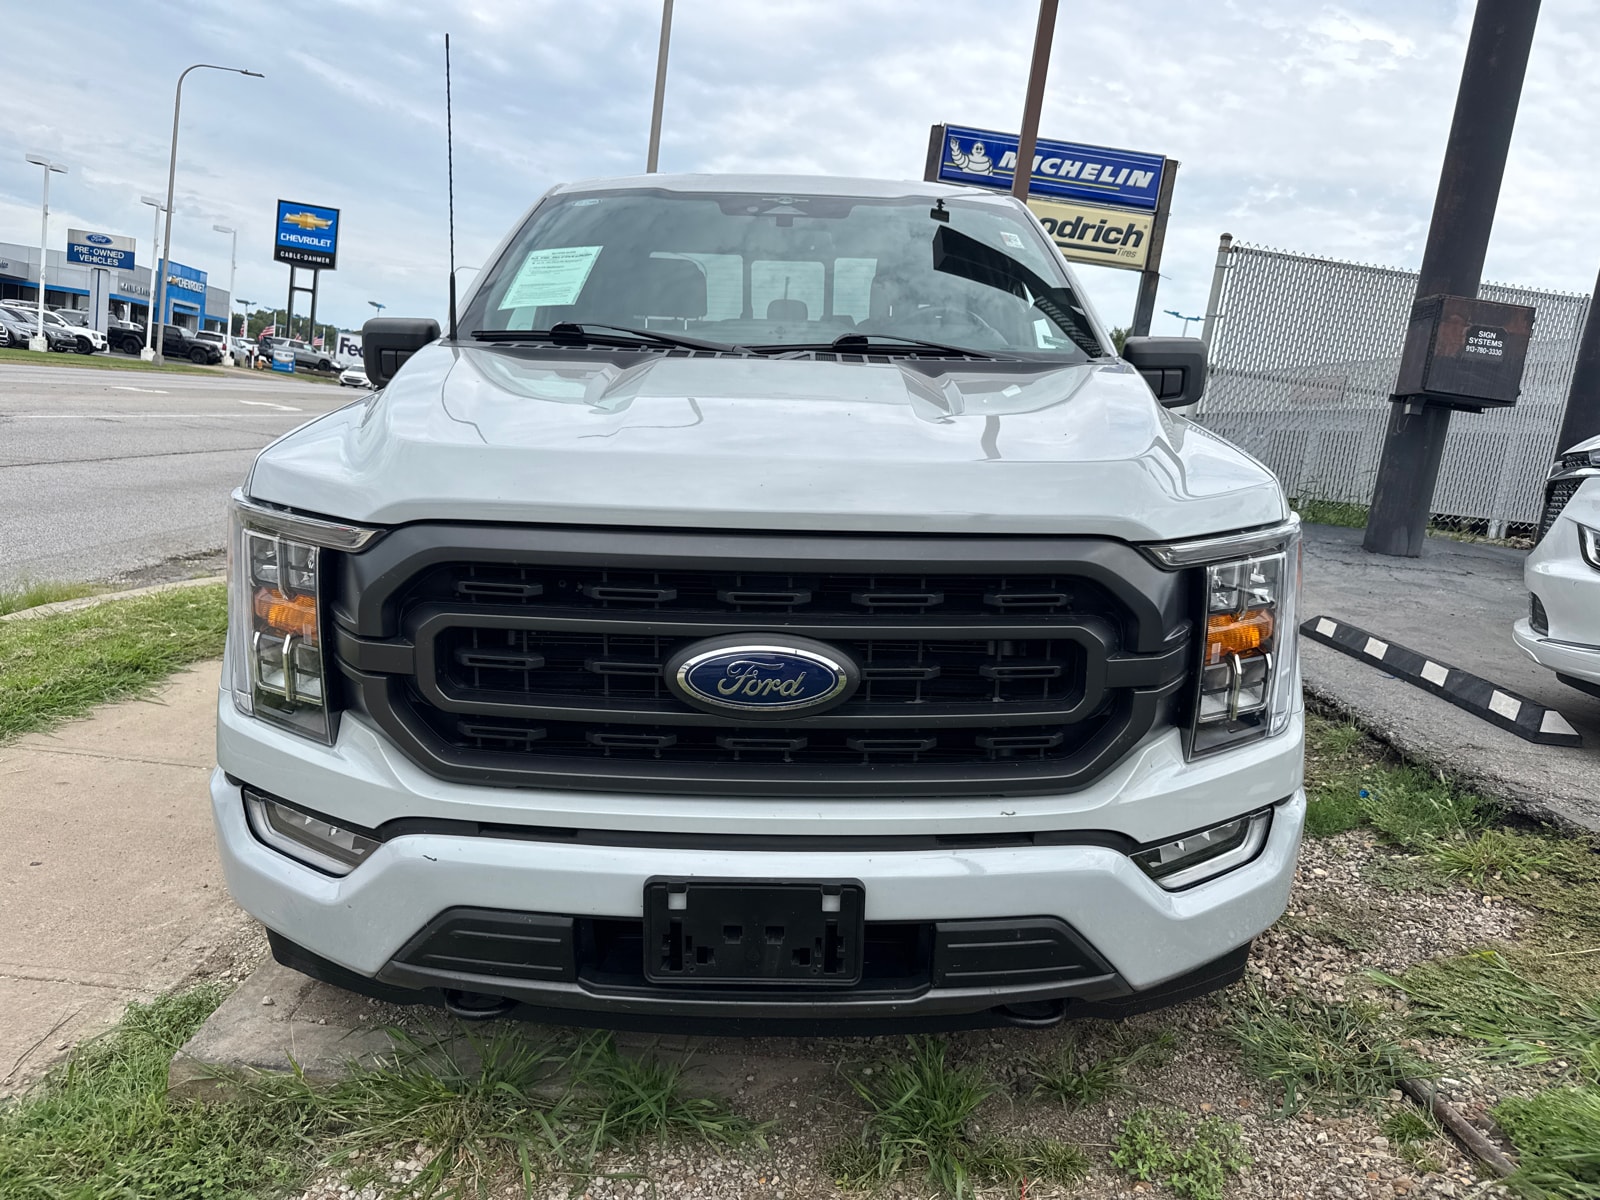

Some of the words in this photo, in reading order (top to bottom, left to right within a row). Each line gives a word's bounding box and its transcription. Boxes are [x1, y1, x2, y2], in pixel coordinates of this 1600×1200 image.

[280, 232, 332, 247] CHEVROLET
[74, 245, 125, 259] PRE-OWNED
[280, 251, 330, 264] CABLE-DAHMER
[1116, 247, 1137, 258] Tires
[79, 254, 119, 266] VEHICLES
[1478, 330, 1497, 339] SIGN
[1469, 337, 1503, 348] SYSTEMS
[717, 660, 806, 697] Ford
